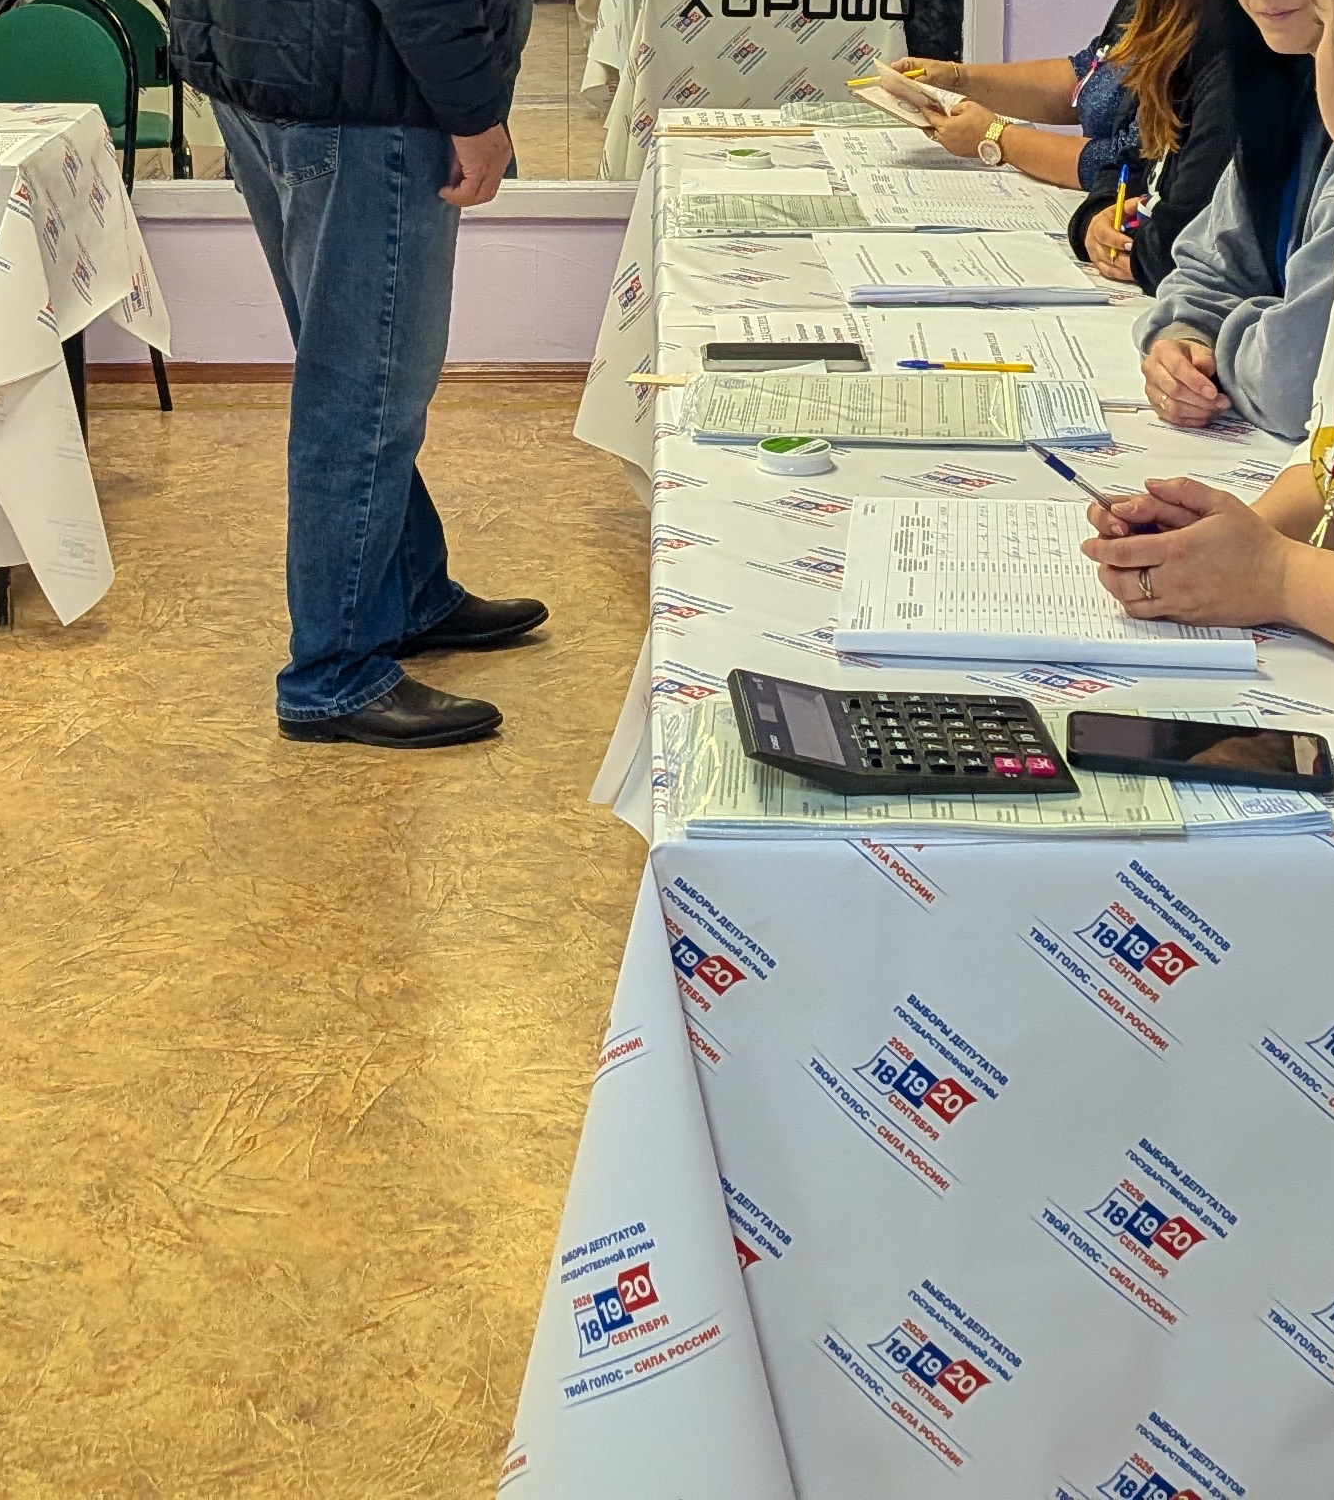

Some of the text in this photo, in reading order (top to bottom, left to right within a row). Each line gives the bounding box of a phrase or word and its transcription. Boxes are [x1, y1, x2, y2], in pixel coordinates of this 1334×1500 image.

[1109, 901, 1136, 925] 2026
[1115, 871, 1221, 964] ГОСУДАРСТВЕННОЙ ДУМЫ
[1128, 859, 1230, 951] ВЫБОРЫ ДЕПУТАТОВ
[1091, 921, 1183, 975] 18 19 20
[1029, 926, 1059, 955] ТВОЙ
[1055, 950, 1090, 983] ГОЛОС
[1097, 988, 1125, 1015] СИЛА
[1124, 1011, 1169, 1051] РОССИИ!
[1108, 952, 1159, 1003] СЕНТЯБРЯ
[887, 1036, 914, 1060] 2026
[893, 1005, 998, 1099] ГОСУДАРСТВЕННОЙ ДУМЫ
[906, 993, 1008, 1085] ВЫБОРЫ ДЕПУТАТОВ
[1260, 1036, 1290, 1064] ТВОЙ
[1286, 1060, 1322, 1092] ГОЛОС
[870, 1057, 963, 1113] 18 19 20
[809, 1057, 837, 1088] ТВОЙ
[834, 1085, 870, 1120] ГОЛОС
[877, 1125, 905, 1153] СИЛА
[904, 1148, 949, 1191] РОССИИ!
[887, 1089, 940, 1141] СЕНТЯБРЯ
[1119, 1178, 1145, 1202] 2026
[1124, 1149, 1228, 1239] ГОСУДАРСТВЕННОЙ ДУМЫ
[1138, 1137, 1237, 1225] ВЫБОРЫ ДЕПУТАТОВ
[589, 1223, 646, 1254] ДЕПУТАТОВ
[626, 1239, 655, 1259] ДУМЫ
[1102, 1199, 1191, 1250] 18 19 20
[1041, 1207, 1070, 1235] ТВОЙ
[1067, 1231, 1102, 1263] ГОЛОС
[1108, 1266, 1135, 1292] СИЛА
[1134, 1287, 1177, 1325] РОССИИ!
[1119, 1230, 1168, 1278] СЕНТЯБРЯ
[572, 1294, 592, 1309] 2026
[581, 1277, 650, 1343] 18 19 20
[921, 1278, 1022, 1367] ВЫБОРЫ ДЕПУТАТОВ
[611, 1316, 670, 1345] СЕНТЯБРЯ
[901, 1318, 928, 1342] 2026
[907, 1289, 1012, 1381] ГОСУДАРСТВЕННОЙ ДУМЫ
[564, 1377, 589, 1398] ТВОЙ
[588, 1369, 623, 1390] ГОЛОС
[634, 1353, 667, 1373] СИЛА
[668, 1325, 720, 1358] РОССИИ!
[885, 1337, 976, 1393] 18 19 20
[823, 1334, 852, 1364] ТВОЙ
[849, 1361, 883, 1395] ГОЛОС
[890, 1401, 918, 1428] СИЛА
[917, 1423, 963, 1467] РОССИИ!
[901, 1367, 953, 1419] СЕНТЯБРЯ
